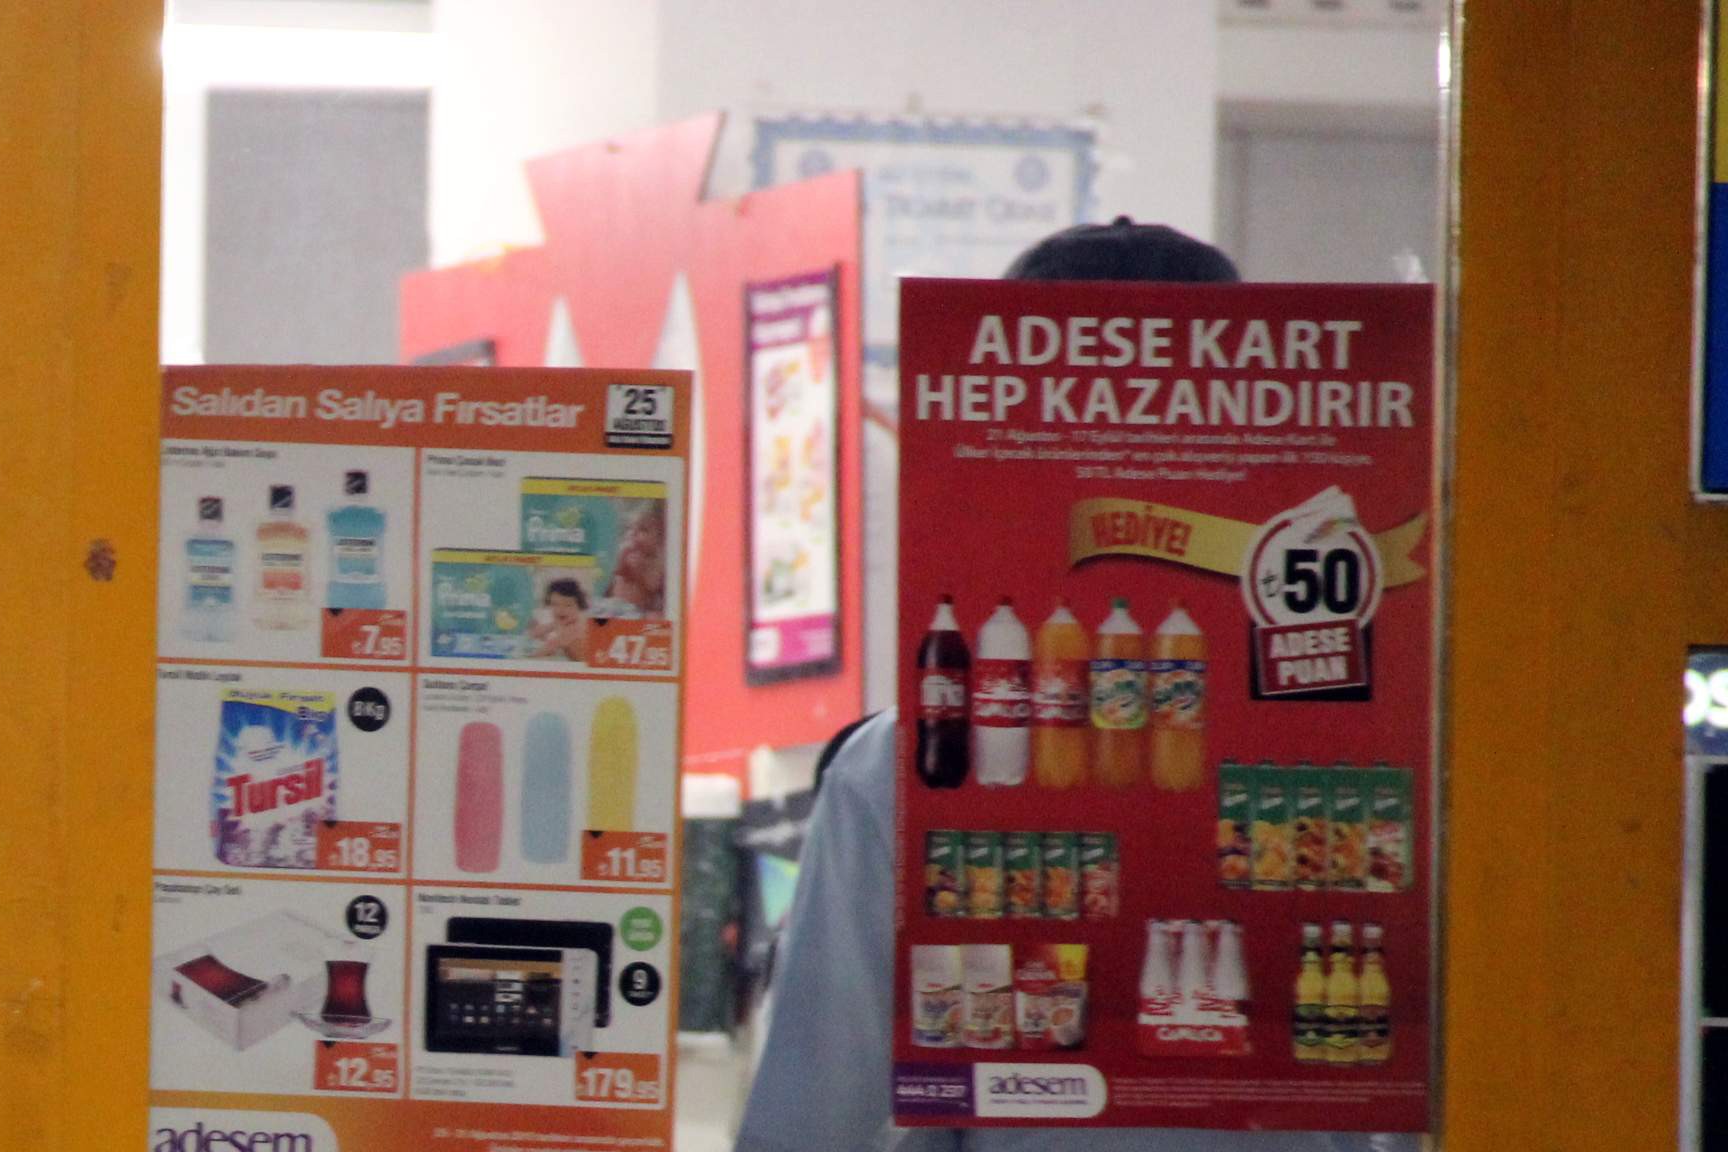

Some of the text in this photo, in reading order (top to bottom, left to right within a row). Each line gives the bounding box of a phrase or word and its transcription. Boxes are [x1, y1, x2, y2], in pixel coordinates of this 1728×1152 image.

[971, 315, 1363, 371] ADESE KART
[172, 386, 585, 428] Salıdan Salıya Fırsatlar
[624, 388, 656, 415] 25
[915, 374, 1414, 428] HEP KAZANDIRIR
[1270, 627, 1353, 658] ADESE
[226, 757, 324, 817] Tursil
[354, 902, 378, 922] 12
[632, 969, 648, 990] 9
[989, 1072, 1089, 1096] adesem
